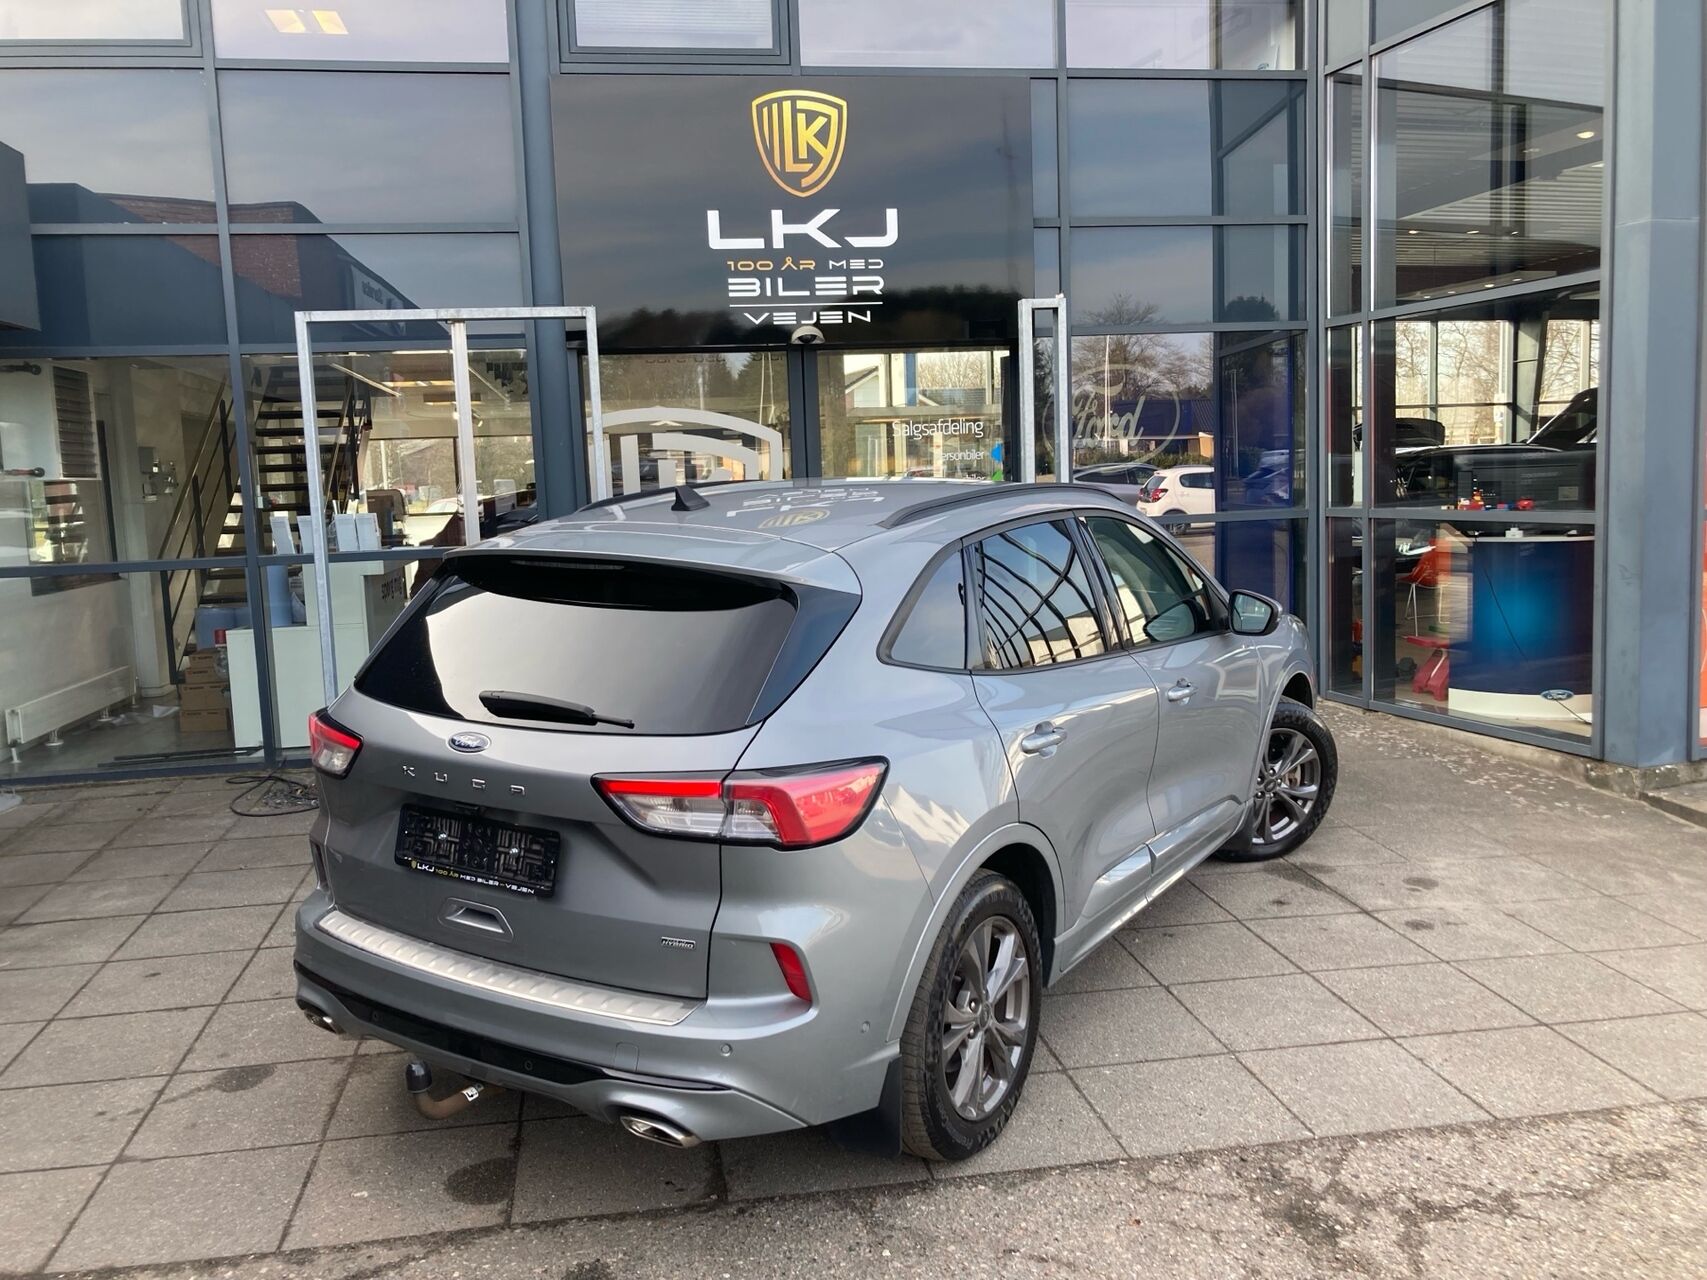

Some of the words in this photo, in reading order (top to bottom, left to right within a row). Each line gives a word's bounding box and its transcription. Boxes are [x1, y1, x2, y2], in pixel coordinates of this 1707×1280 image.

[706, 208, 899, 249] LKJ
[726, 260, 774, 271] 100
[781, 256, 816, 271] ÅR
[829, 259, 884, 270] MED
[727, 275, 885, 297] BILER
[743, 311, 871, 325] VEJEN
[1070, 382, 1146, 448] Ford
[892, 419, 984, 440] Salgsafdeling
[940, 448, 984, 461] ersonbiler
[402, 765, 526, 796] KUGA
[416, 863, 435, 873] LKJ
[460, 874, 476, 882] MED
[477, 878, 500, 886] BILER
[505, 883, 535, 895] VEJEN
